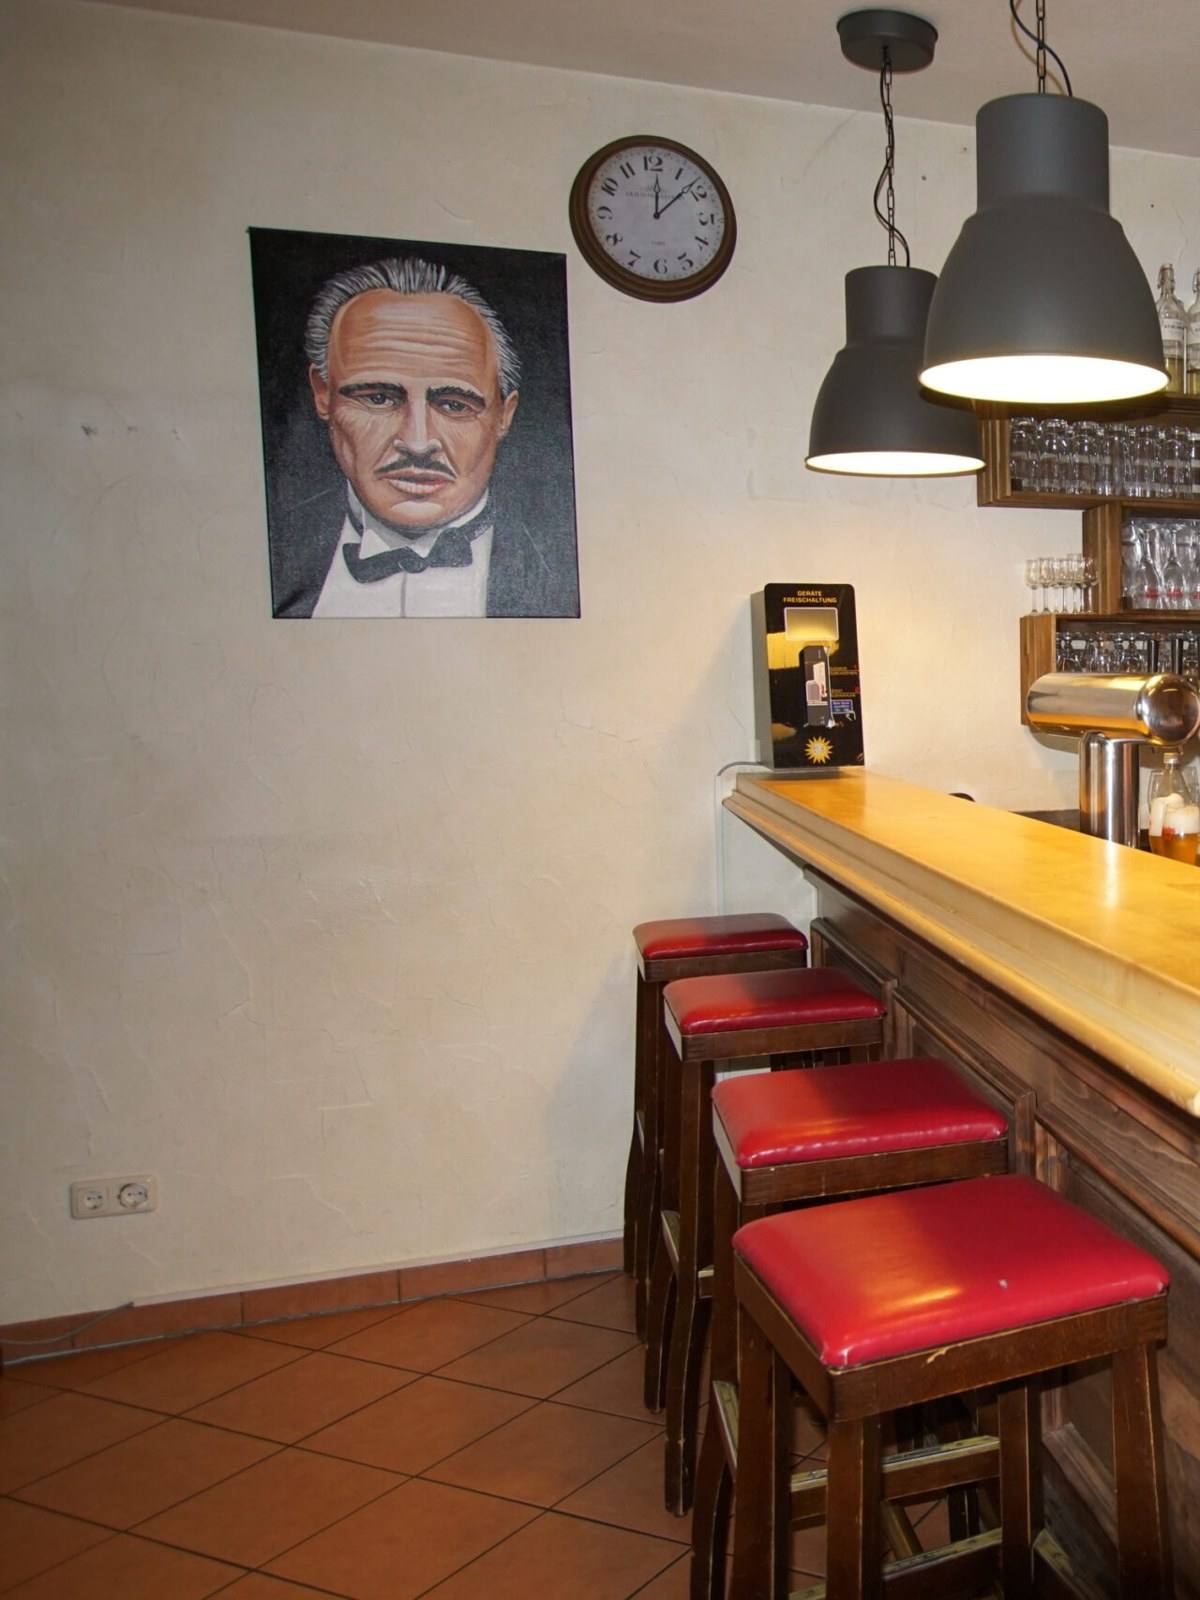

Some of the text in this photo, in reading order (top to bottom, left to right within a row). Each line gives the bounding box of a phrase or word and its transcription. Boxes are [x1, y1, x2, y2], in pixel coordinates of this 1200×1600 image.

[619, 162, 636, 179] 11
[643, 155, 664, 172] 12
[675, 167, 684, 181] 1
[601, 177, 619, 197] 10
[691, 185, 708, 202] 2
[597, 205, 614, 221] 9
[698, 211, 715, 226] 3
[606, 232, 624, 246] 8
[694, 235, 709, 251] 4
[627, 249, 642, 268] 7
[653, 257, 668, 275] 6
[677, 251, 695, 271] 5
